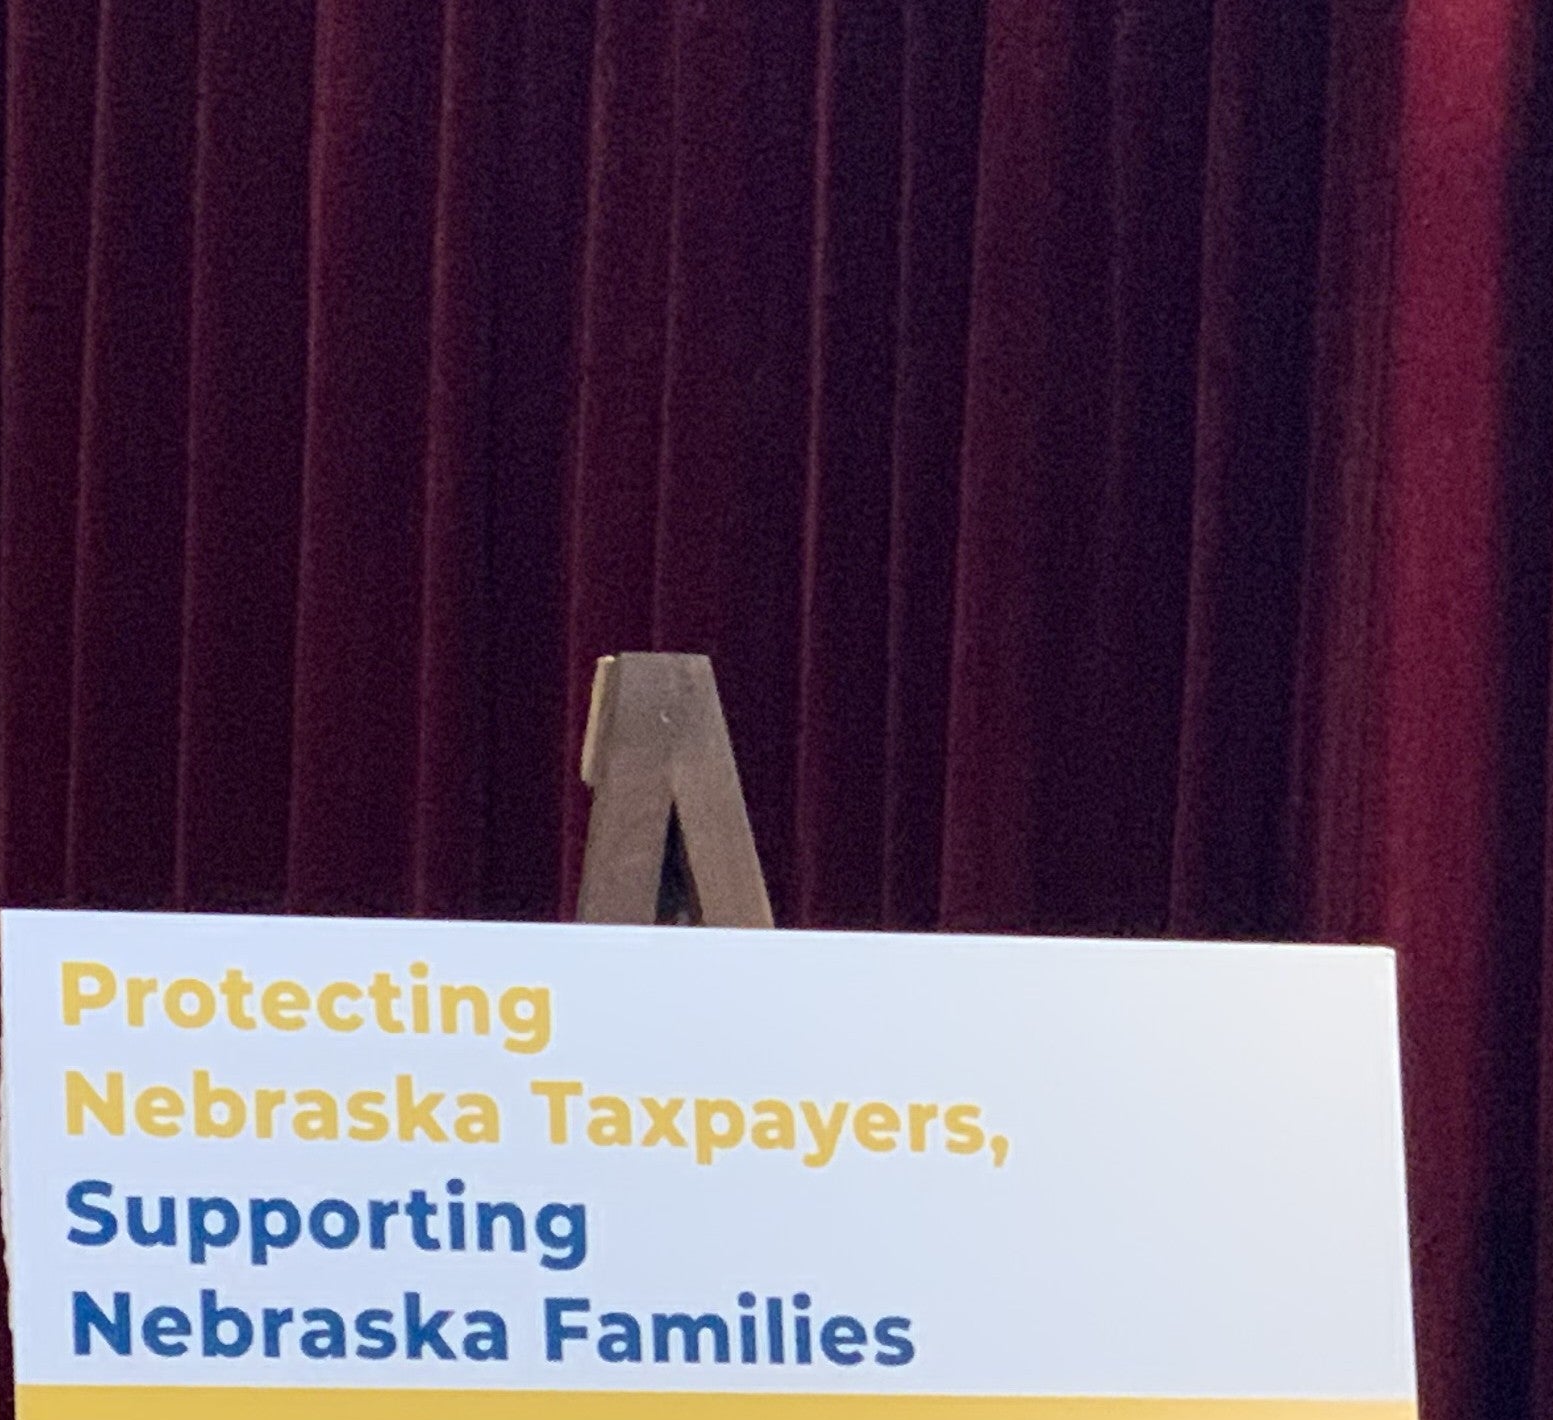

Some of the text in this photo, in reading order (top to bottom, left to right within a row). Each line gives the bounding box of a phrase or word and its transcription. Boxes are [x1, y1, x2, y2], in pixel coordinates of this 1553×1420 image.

[61, 961, 552, 1055] Protecting
[65, 1069, 1009, 1168] Nebraska Taxpayers,
[66, 1178, 587, 1271] Supporting
[72, 1288, 915, 1366] Nebraska Families
